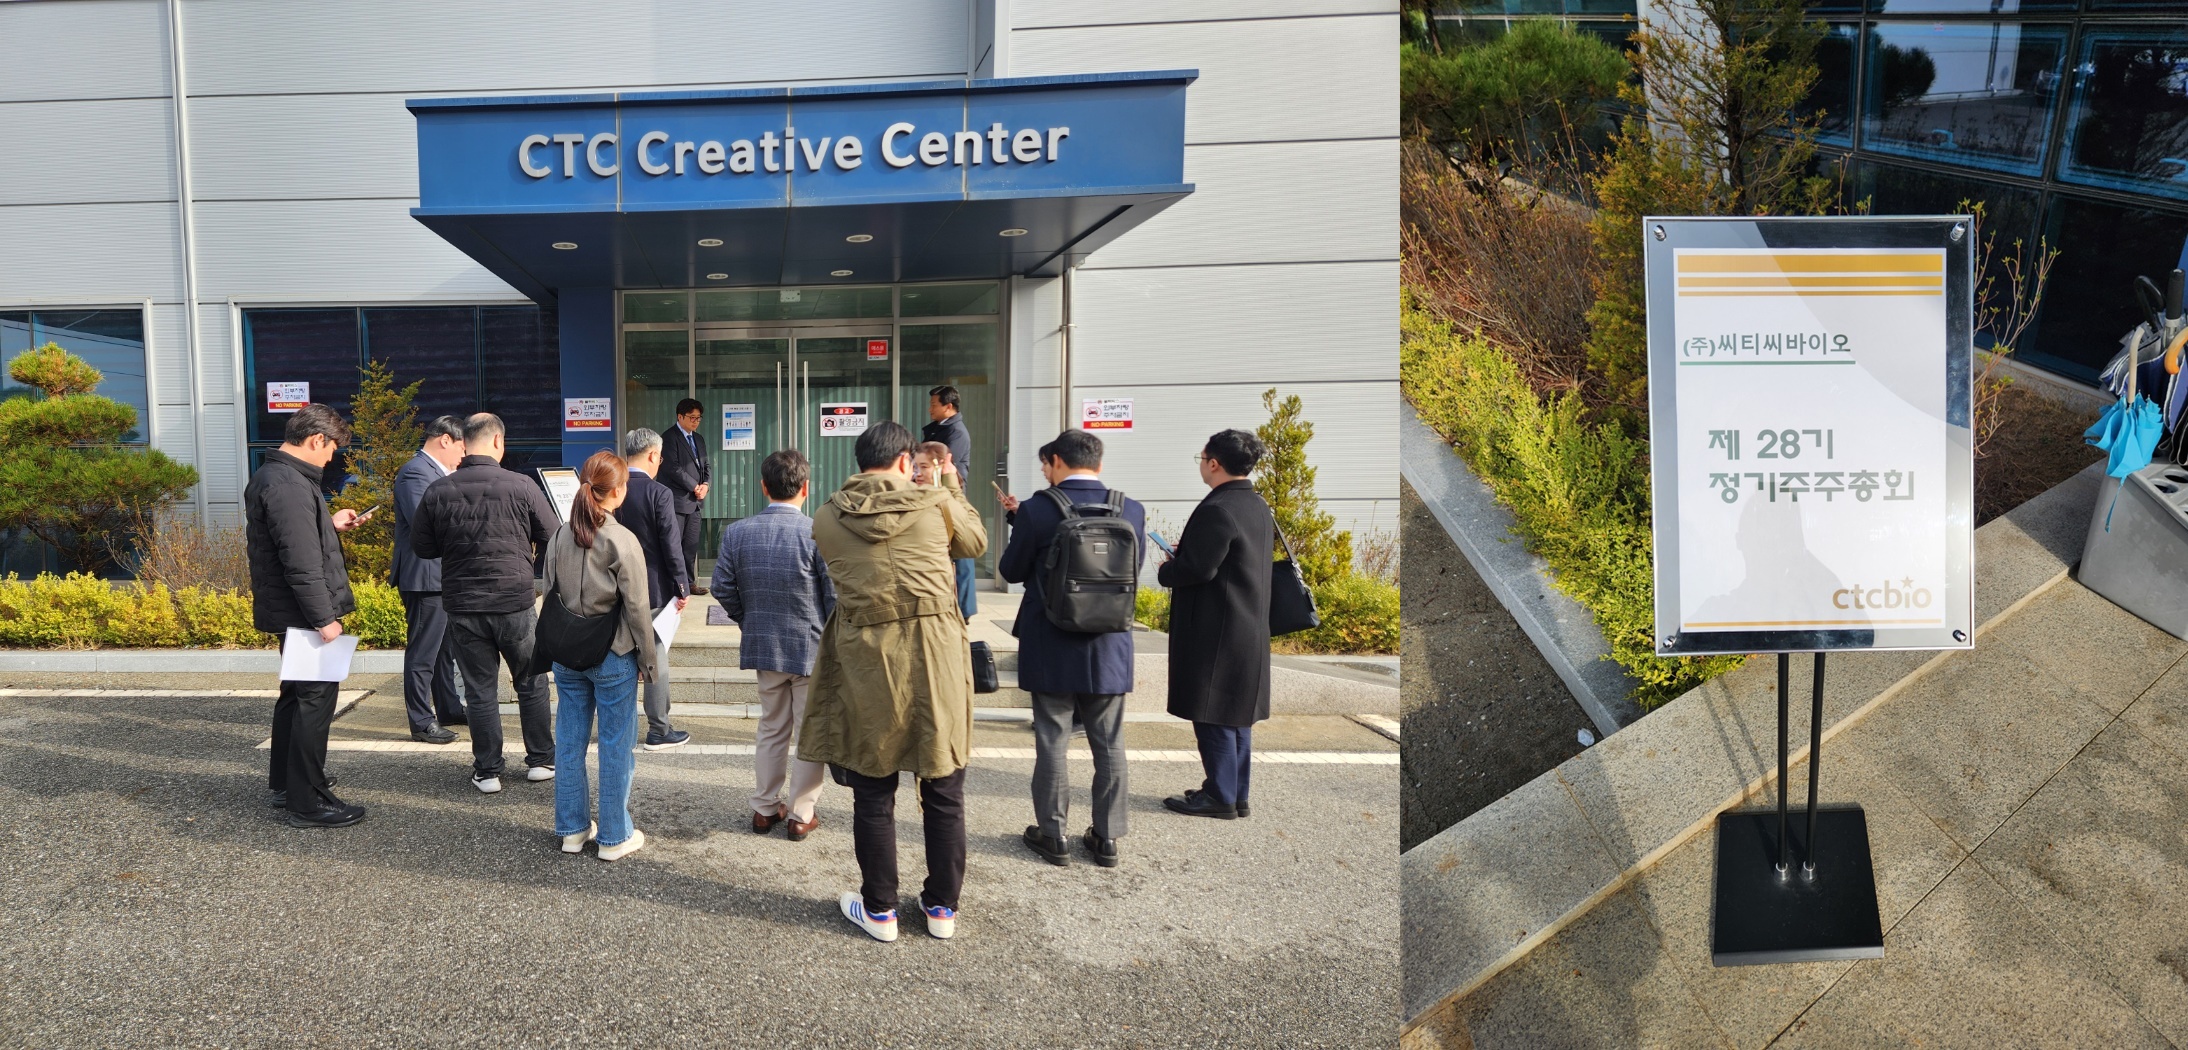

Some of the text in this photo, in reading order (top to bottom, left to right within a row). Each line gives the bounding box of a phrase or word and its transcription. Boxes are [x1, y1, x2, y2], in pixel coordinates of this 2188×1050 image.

[518, 122, 1070, 178] CTC Creative Center
[1682, 332, 1851, 357] (주)씨티씨바이오
[1708, 428, 1834, 460] 제 28기
[1708, 469, 1915, 504] 정기주주총회
[1832, 576, 1932, 610] ctcbio
